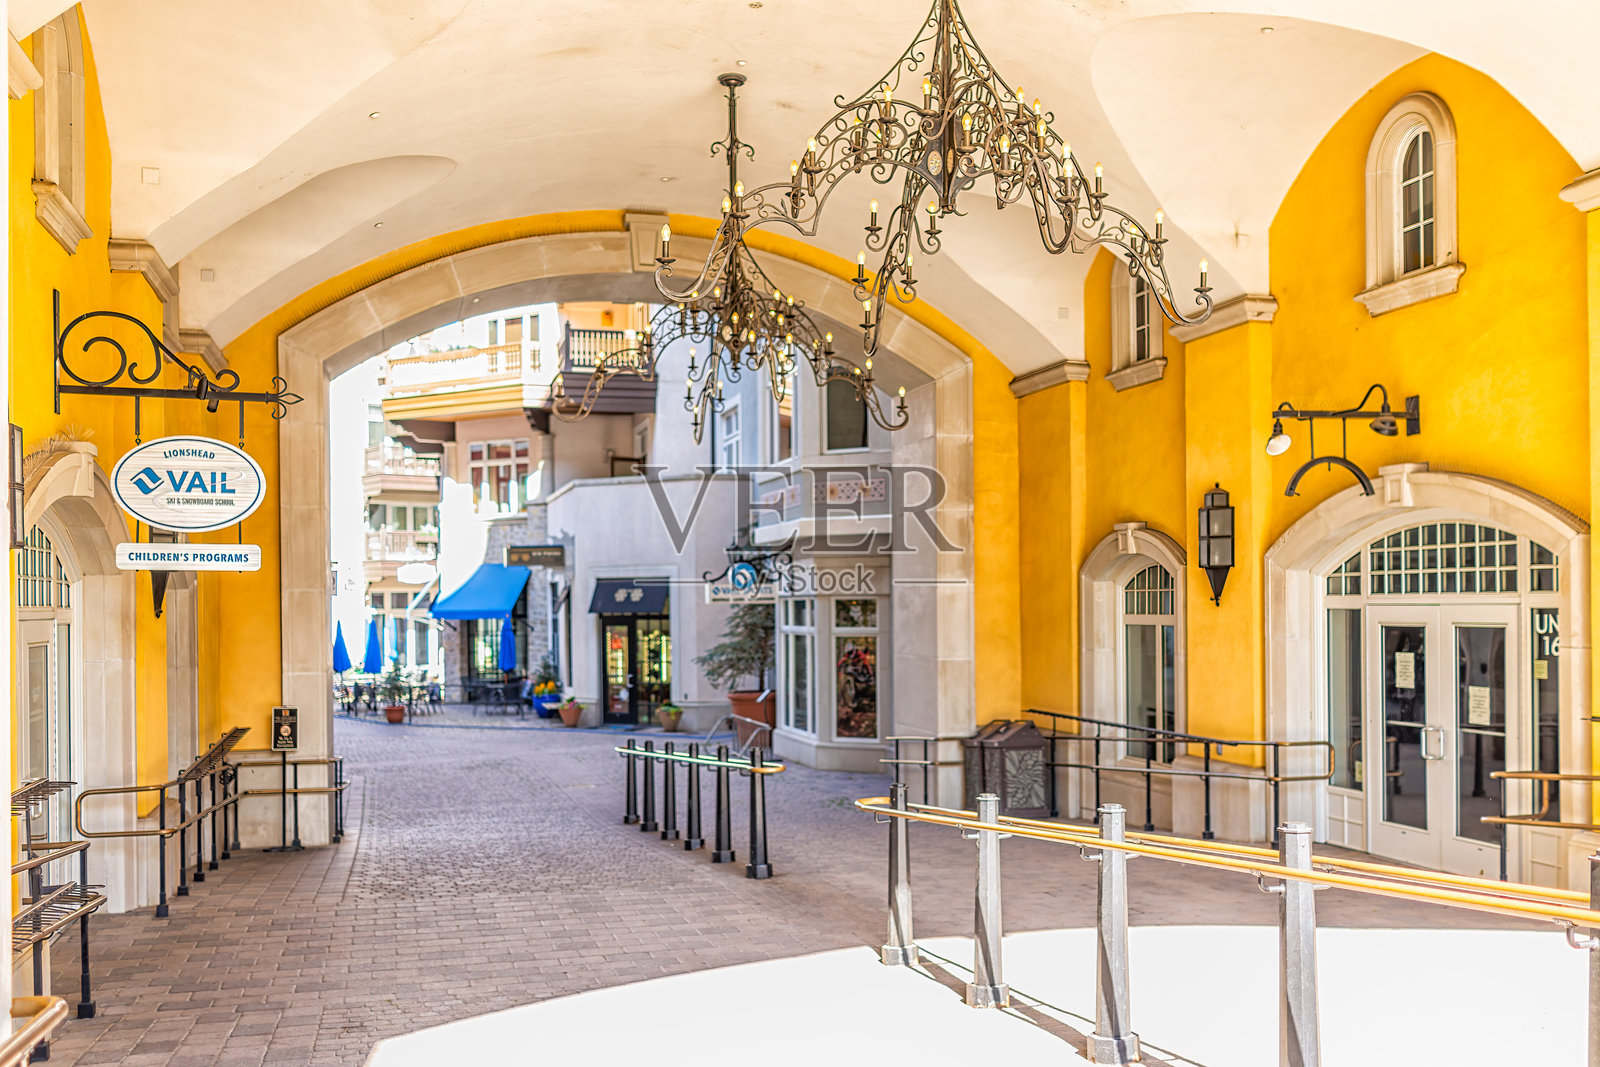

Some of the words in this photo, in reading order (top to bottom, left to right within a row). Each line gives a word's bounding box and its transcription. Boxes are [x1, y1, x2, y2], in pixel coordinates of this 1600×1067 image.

[163, 449, 216, 460] LIONSHEAD
[166, 470, 236, 494] VAIL
[166, 497, 176, 505] SKI
[182, 498, 214, 506] SNOWBOARD
[215, 498, 236, 507] SCHOOL
[128, 552, 189, 562] CHILDREN'S
[192, 553, 249, 563] PROGRAMS
